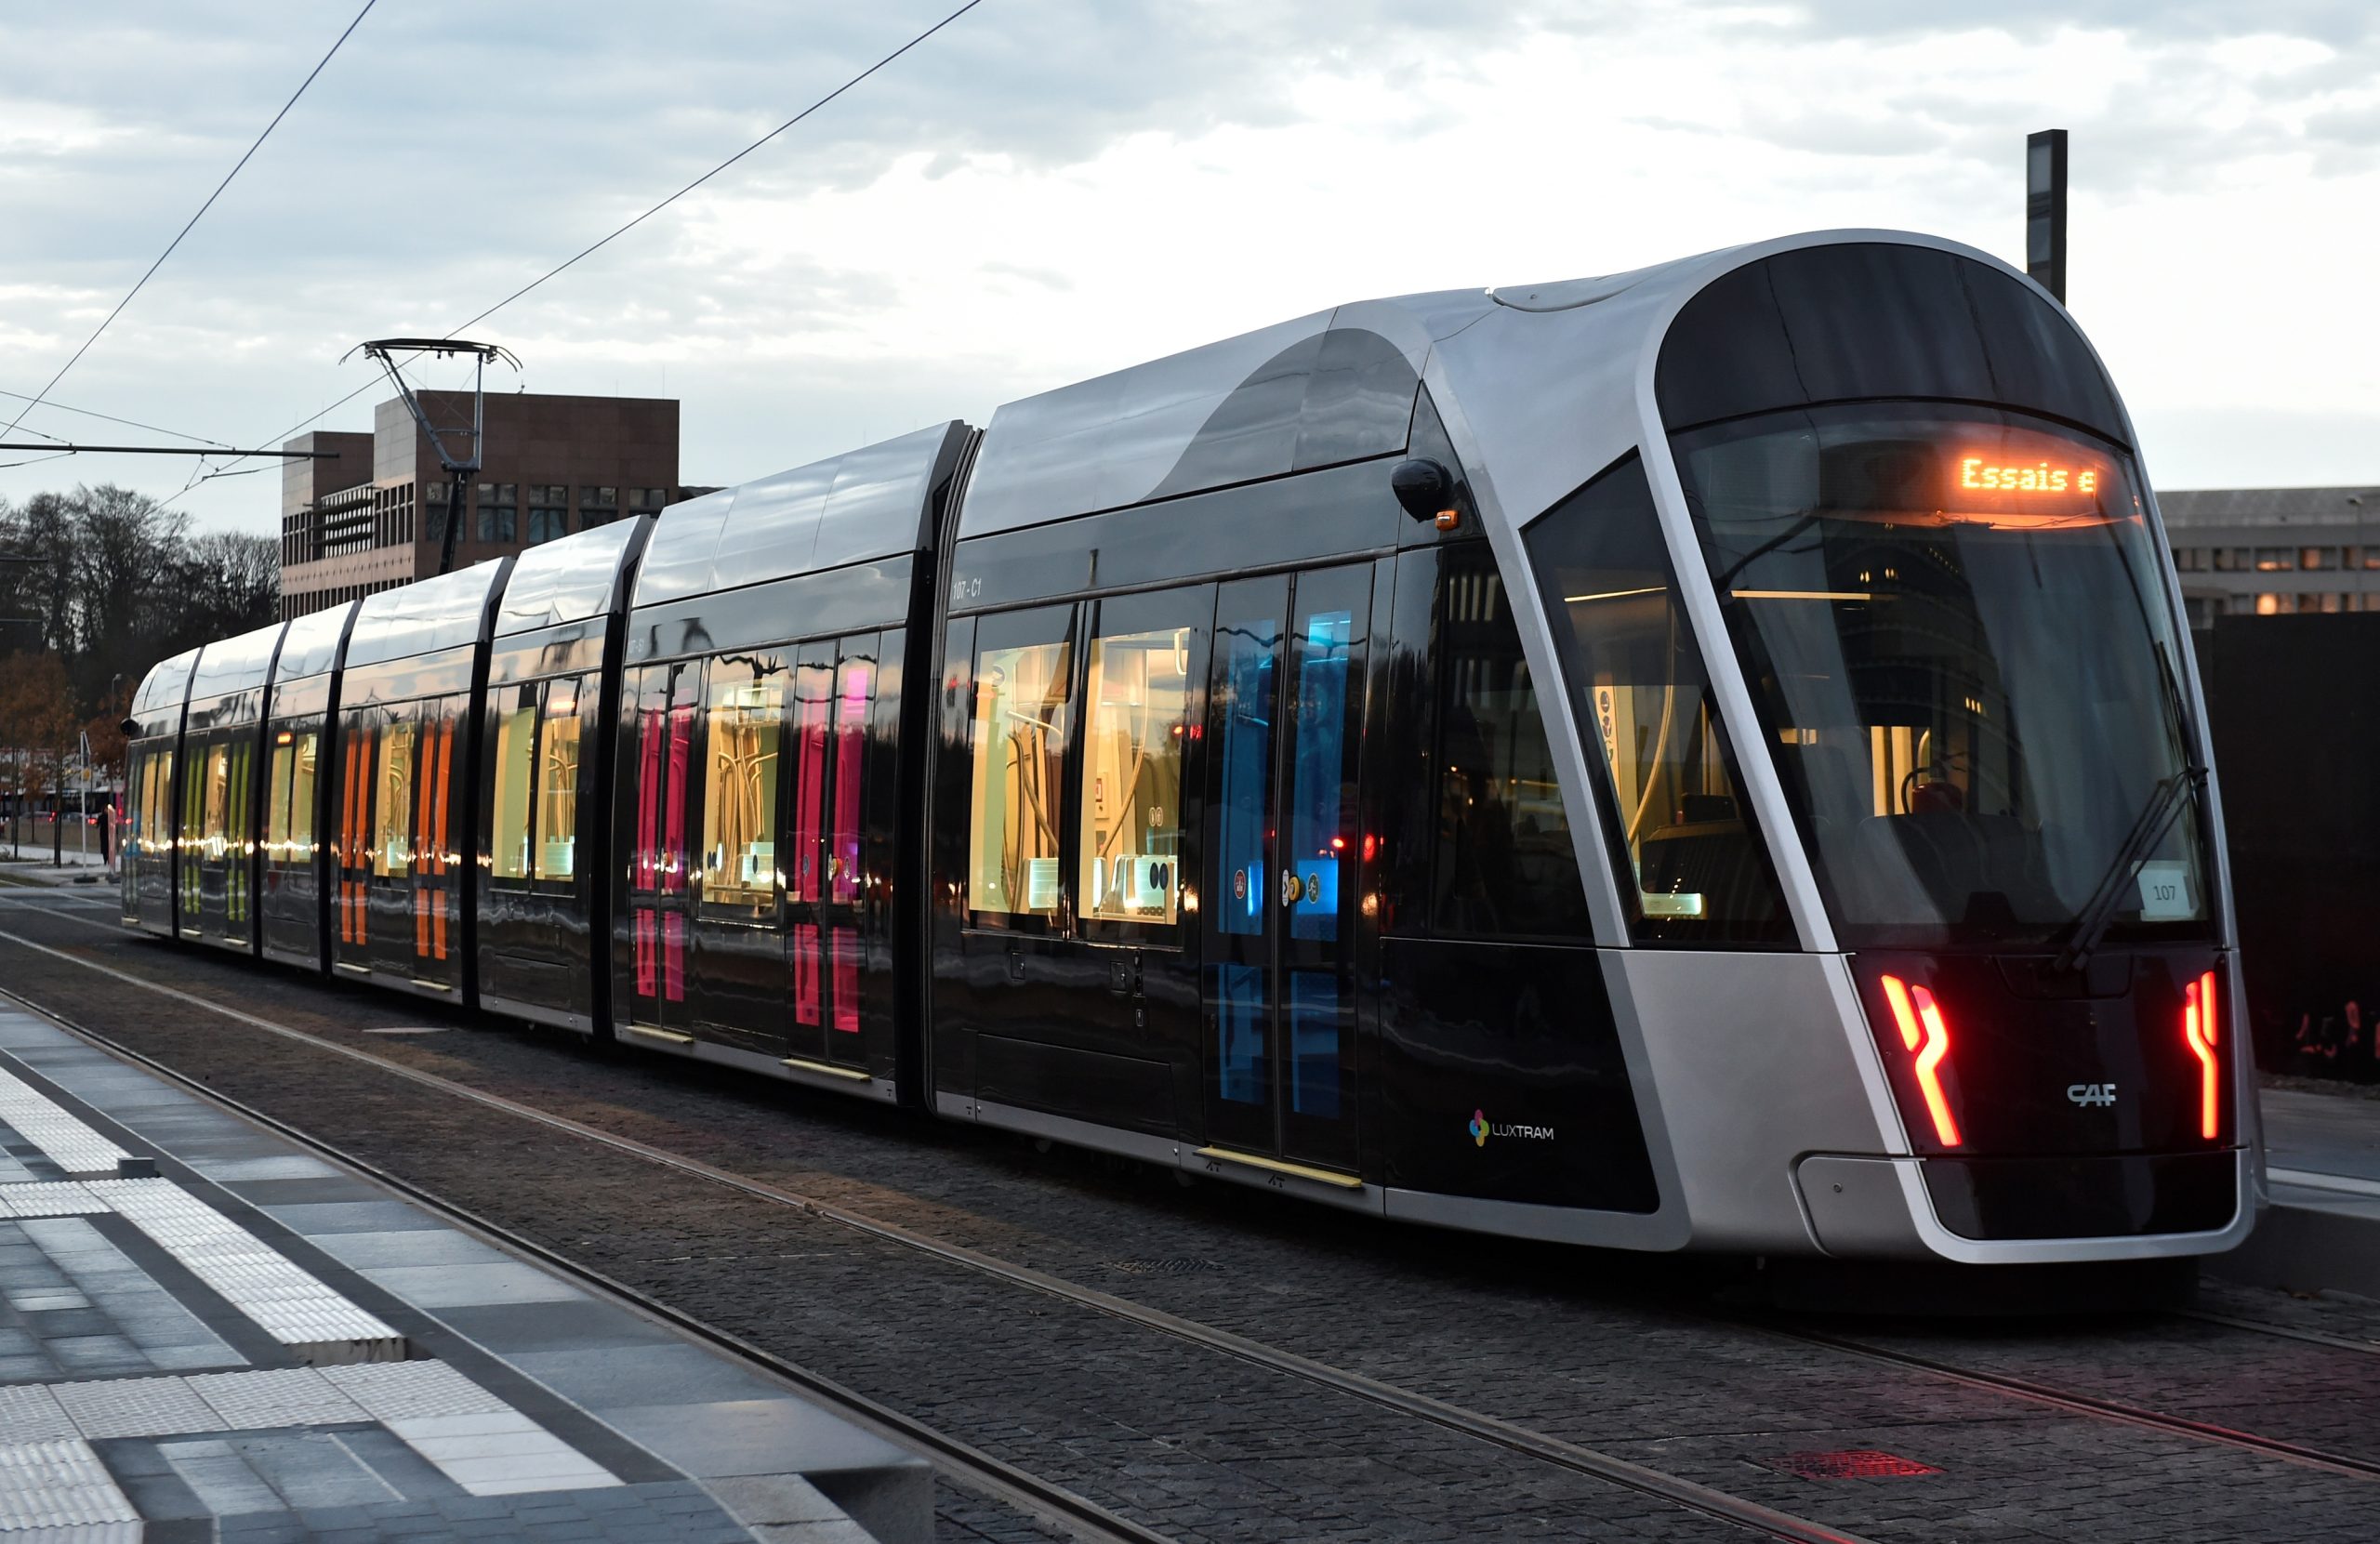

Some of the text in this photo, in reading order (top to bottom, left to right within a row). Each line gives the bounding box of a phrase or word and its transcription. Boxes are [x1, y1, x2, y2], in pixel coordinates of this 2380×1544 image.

[1962, 458, 2069, 492] Essais
[2152, 885, 2175, 901] 107
[2067, 1083, 2116, 1107] CAF
[1492, 1123, 1554, 1141] LUXTRAM
